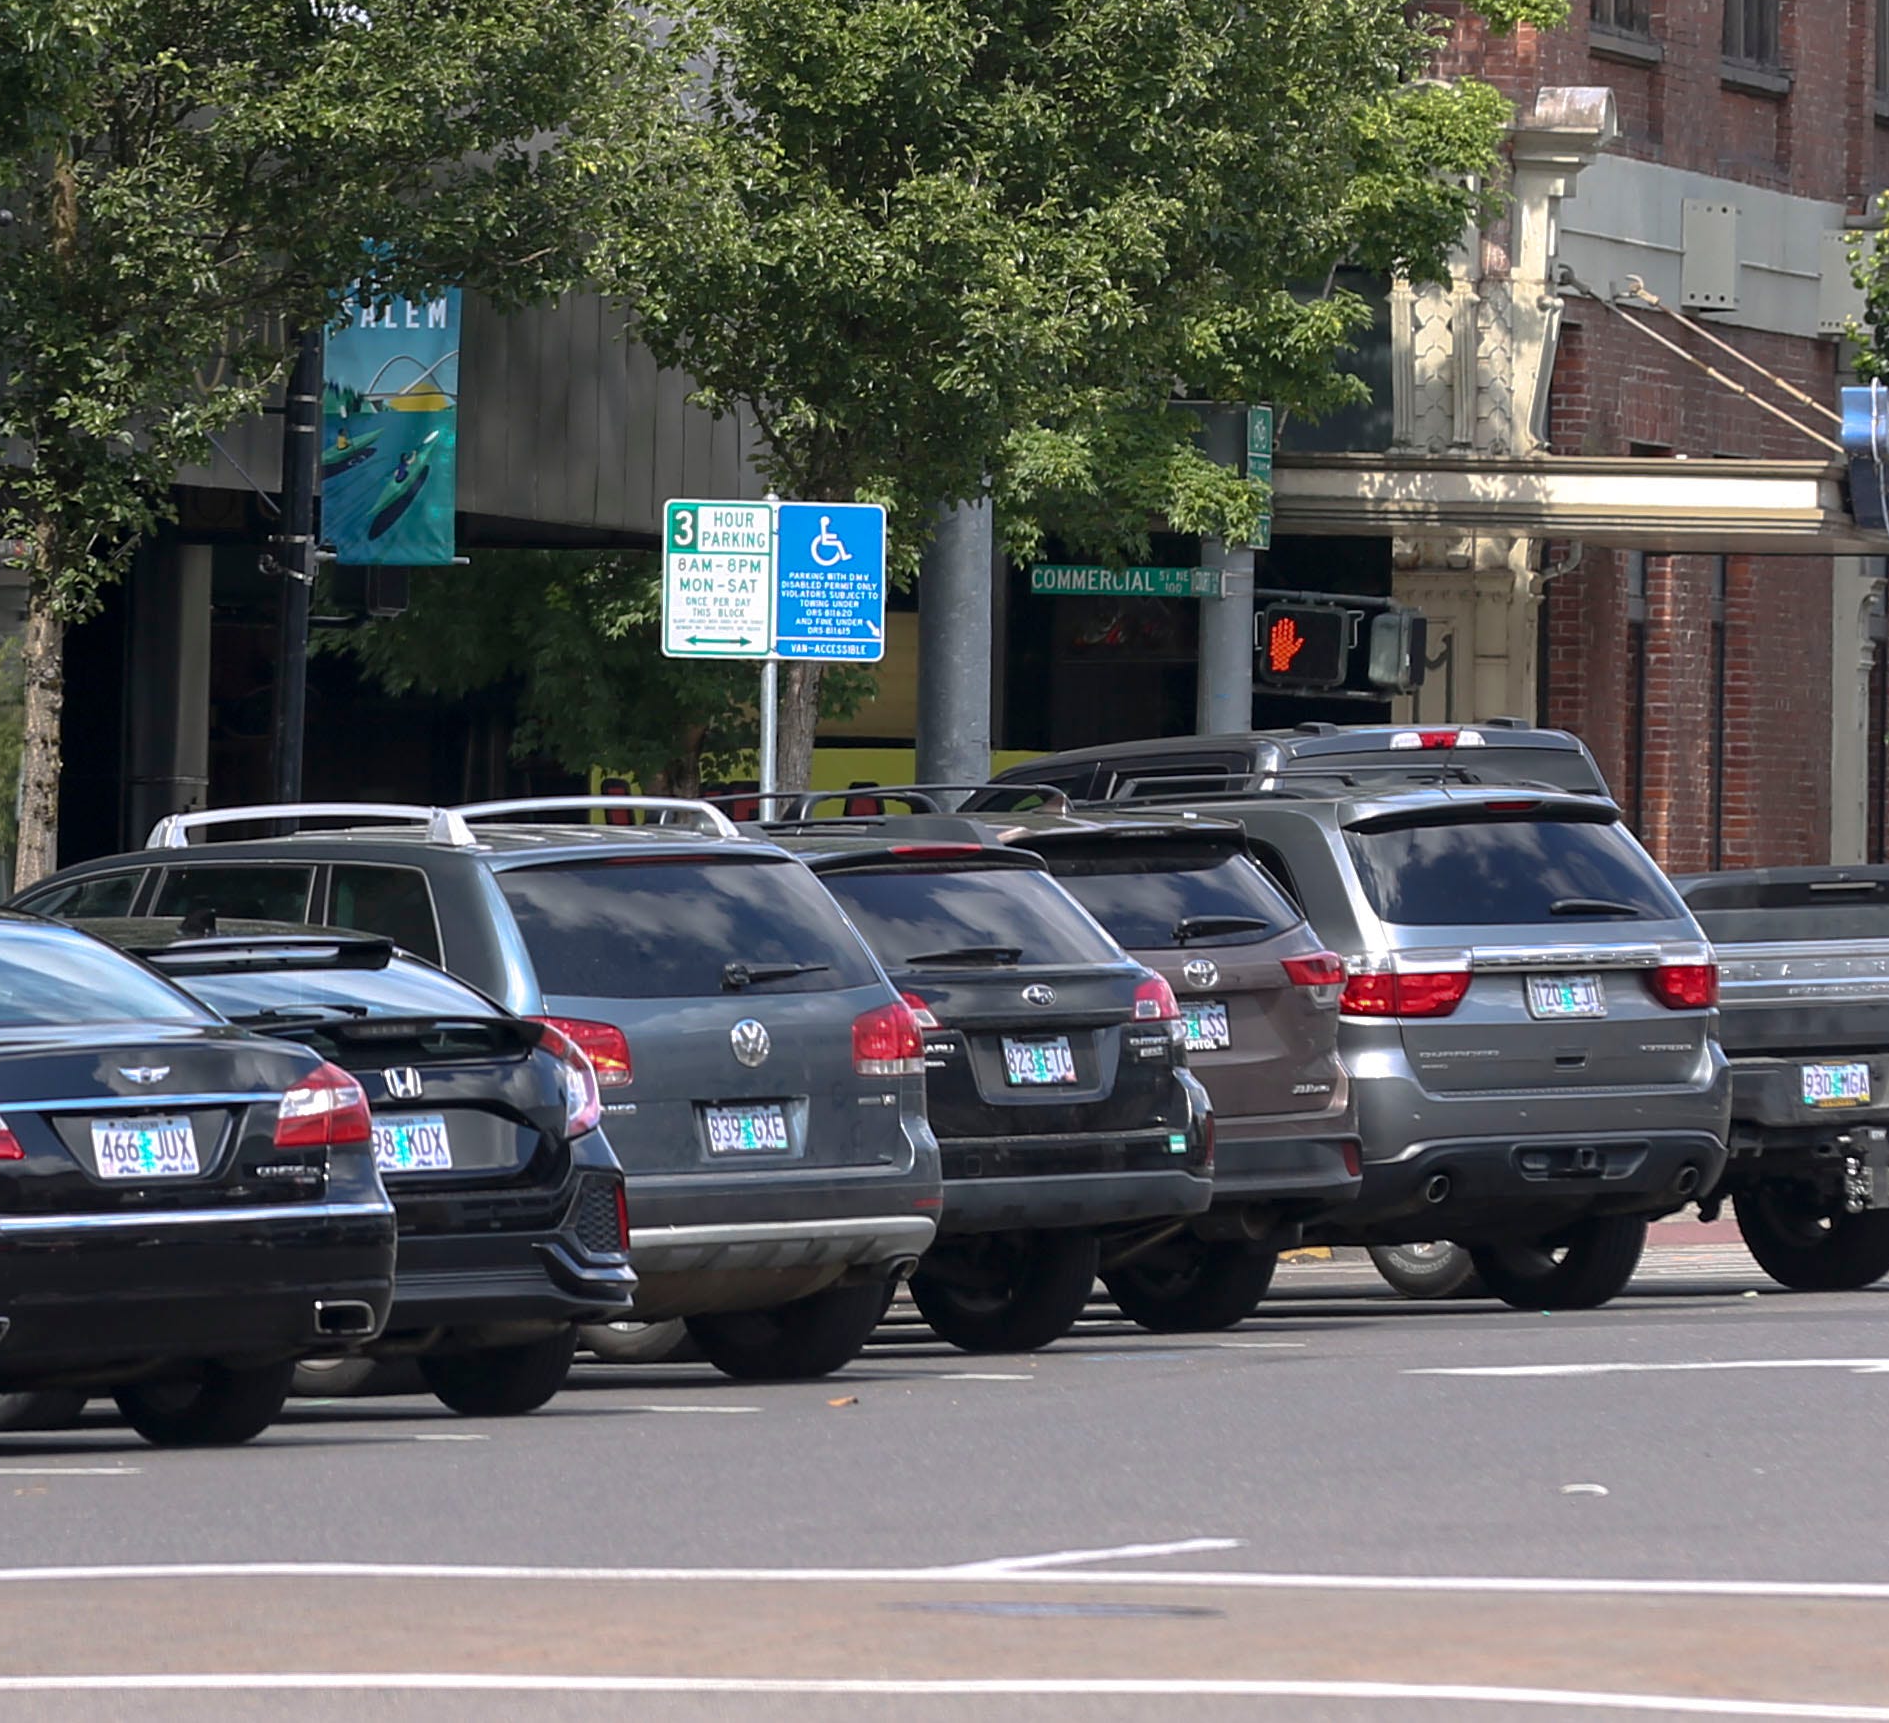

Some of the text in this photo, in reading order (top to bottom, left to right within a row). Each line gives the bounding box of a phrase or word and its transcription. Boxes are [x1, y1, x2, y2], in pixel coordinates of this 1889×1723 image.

[714, 511, 755, 529] HOUR
[673, 509, 694, 547] 3
[702, 530, 766, 549] PARKING
[789, 571, 825, 580] PARKING
[827, 572, 847, 580] WITH
[1031, 567, 1156, 592] COMMERCIAL
[1175, 571, 1190, 583] NE
[781, 580, 878, 591] DISABLED PERMIT ONLY
[713, 597, 730, 606] PER
[735, 597, 752, 607] DAY
[781, 590, 879, 600] VIOLATORS SUBJECT TO
[800, 599, 860, 608] TOWING UNDER
[692, 607, 745, 618] THIS BLOCK
[795, 617, 864, 627] AND FINE UNDER
[791, 643, 867, 655] VAN-ACCESSIBLE
[1196, 1012, 1227, 1038] LSS
[1185, 1039, 1217, 1051] APITOL
[1007, 1048, 1036, 1074] 823
[711, 1114, 785, 1143] 839 GXE
[101, 1128, 193, 1163] 466 JUX
[373, 1126, 446, 1157] 98 KDX
